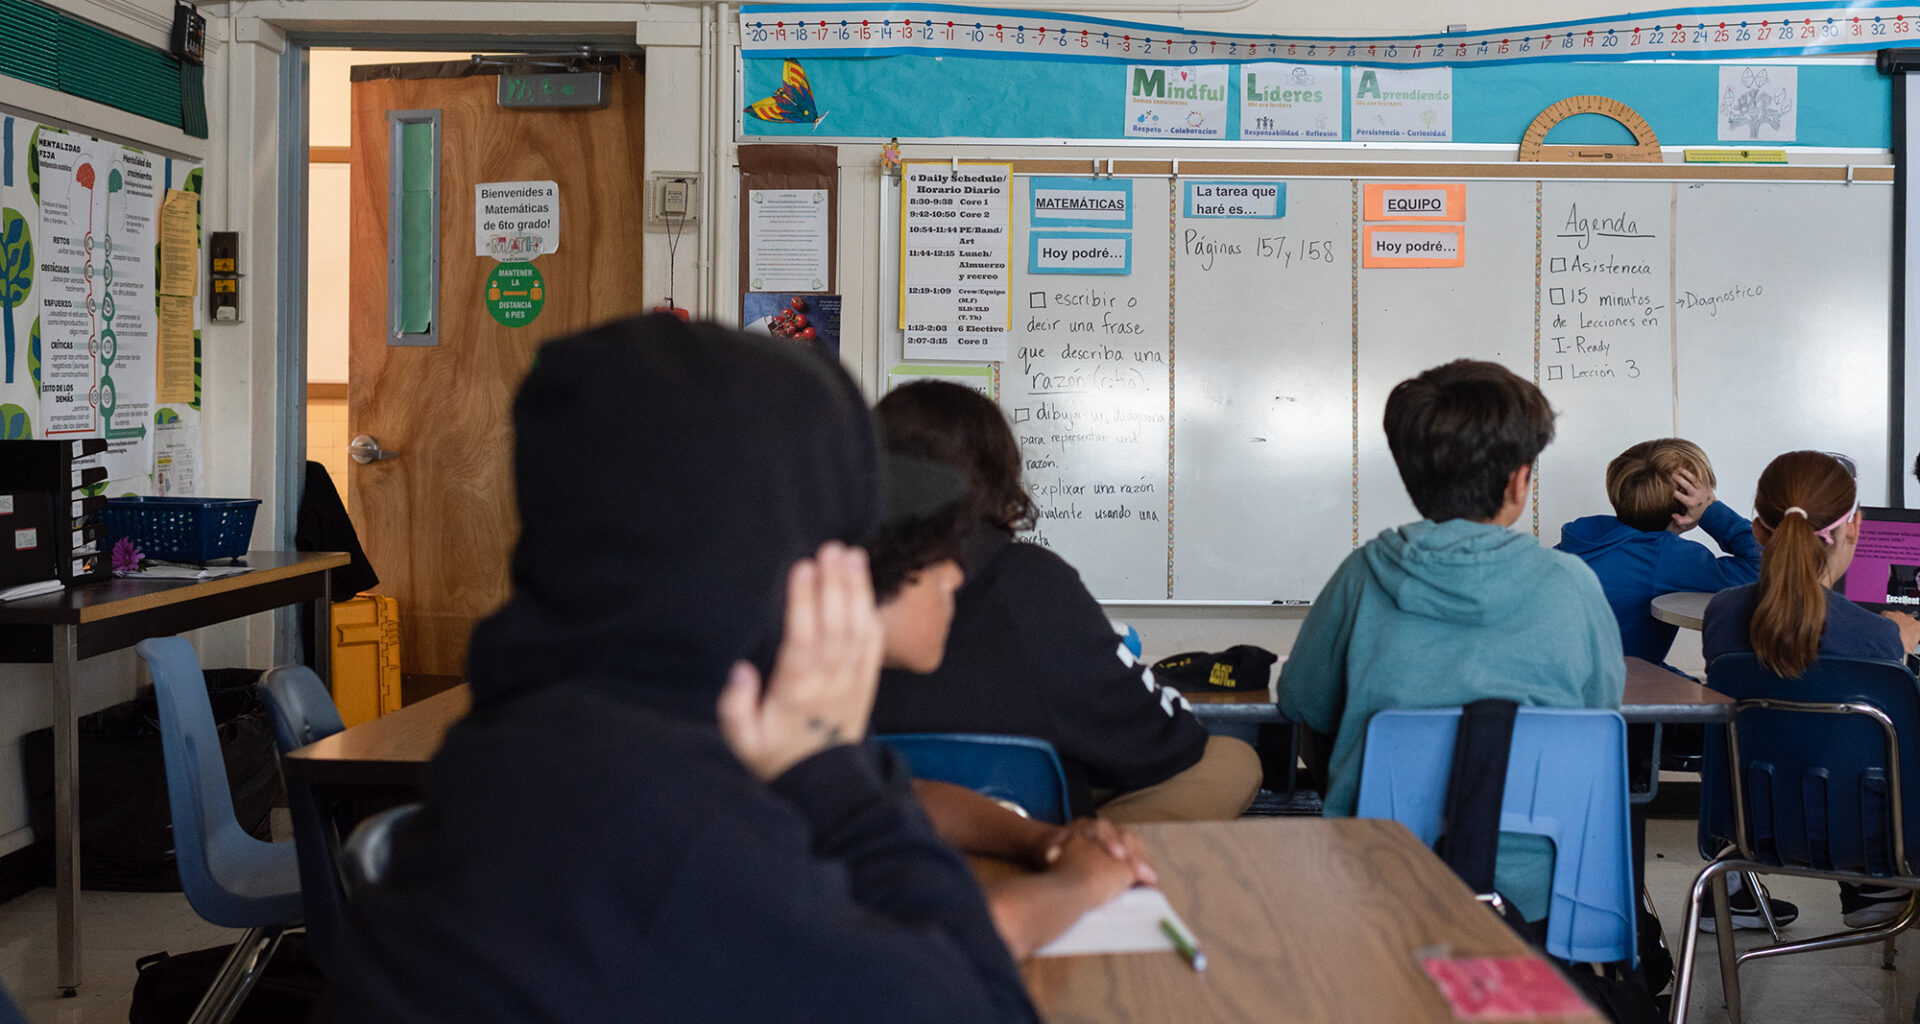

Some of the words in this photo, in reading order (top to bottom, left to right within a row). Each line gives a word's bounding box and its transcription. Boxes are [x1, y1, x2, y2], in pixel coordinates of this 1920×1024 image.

[746, 30, 768, 42] -20
[770, 30, 786, 42] -19
[790, 30, 808, 41] -18
[812, 29, 828, 40] -17
[832, 28, 850, 40] -16
[854, 28, 871, 40] -15
[875, 28, 892, 40] -14
[896, 28, 913, 39] -13
[916, 28, 934, 40] -12
[940, 29, 954, 40] -11
[966, 30, 984, 42] -10
[989, 32, 1003, 43] -9
[1010, 33, 1025, 44] -8
[1032, 34, 1046, 46] -7
[1053, 35, 1068, 46] -6
[1074, 36, 1088, 48] -5
[1096, 38, 1110, 50] -4
[1117, 42, 1131, 52] -3
[1138, 44, 1152, 54] -2
[1162, 46, 1171, 54] -1
[1433, 48, 1444, 57] 12
[1456, 47, 1467, 57] 13
[1477, 46, 1488, 56] 14
[1498, 44, 1509, 54] 15
[1519, 41, 1530, 52] 16
[1541, 39, 1552, 50] 17
[1562, 37, 1574, 48] 18
[1583, 36, 1594, 48] 19
[1602, 35, 1618, 47] 20
[1630, 34, 1641, 46] 21
[1648, 32, 1664, 45] 22
[1670, 32, 1686, 44] 23
[1692, 30, 1708, 43] 24
[1714, 30, 1730, 42] 25
[1736, 30, 1750, 42] 26
[1757, 28, 1772, 40] 27
[1778, 28, 1794, 40] 28
[1800, 26, 1816, 38] 29
[1851, 24, 1862, 36] 31
[1871, 24, 1886, 36] 32
[1892, 22, 1910, 34] 33
[1132, 68, 1224, 101] Mindful
[1356, 70, 1450, 100] Aprendiendo
[1133, 125, 1162, 134] Respeto
[1244, 129, 1298, 137] Responsabilidad
[1356, 128, 1400, 136] Persistencia
[39, 138, 81, 154] MENTALIDAD
[40, 150, 55, 160] FIJA
[918, 174, 948, 184] Daily
[951, 174, 1006, 182] Schedule/
[482, 188, 543, 198] Bienvenides
[546, 188, 553, 196] a
[1196, 186, 1212, 196] La
[1216, 186, 1248, 196] tarea
[1252, 188, 1276, 199] que
[485, 203, 549, 214] Matemáticas
[1036, 197, 1124, 210] MATEMÁTICAS
[1196, 204, 1225, 214] haré
[1388, 198, 1442, 212] EQUIPO
[484, 221, 496, 230] de
[498, 220, 514, 230] 6to
[517, 219, 550, 232] grado!
[1565, 202, 1638, 250] Agenda
[53, 236, 70, 245] RETOS
[1376, 241, 1401, 254] Hoy
[1042, 248, 1070, 260] Hoy
[1184, 228, 1242, 272] Páginas
[1256, 236, 1286, 258] 157
[1284, 251, 1291, 268] y
[1300, 240, 1334, 263] 158
[41, 262, 70, 274] OBSTÁCULOS
[1572, 254, 1652, 274] Asistencia
[1055, 289, 1116, 308] escribir
[1128, 297, 1138, 308] o
[1570, 287, 1588, 304] 15
[1600, 288, 1650, 307] minutos
[1685, 284, 1762, 317] Diagnostico
[1027, 316, 1060, 332] decir
[1070, 322, 1094, 333] una
[1102, 312, 1144, 334] frase
[1553, 314, 1567, 328] de
[1580, 312, 1636, 329] Lecciones
[1642, 317, 1658, 327] en
[51, 339, 73, 350] CRÍTICAS
[1551, 336, 1610, 356] I-Ready
[1018, 346, 1046, 375] que
[1062, 344, 1124, 360] describa
[1134, 349, 1164, 364] una
[1625, 360, 1640, 378] 3
[1032, 368, 1086, 390] razón
[56, 394, 73, 403] DEMÁS
[1021, 436, 1046, 453] para
[1094, 483, 1116, 495] una
[1120, 476, 1155, 494] razón
[1095, 505, 1131, 520] usando
[1139, 511, 1160, 522] una
[1886, 595, 1919, 604] Excellent
[1209, 678, 1236, 687] MATTER
